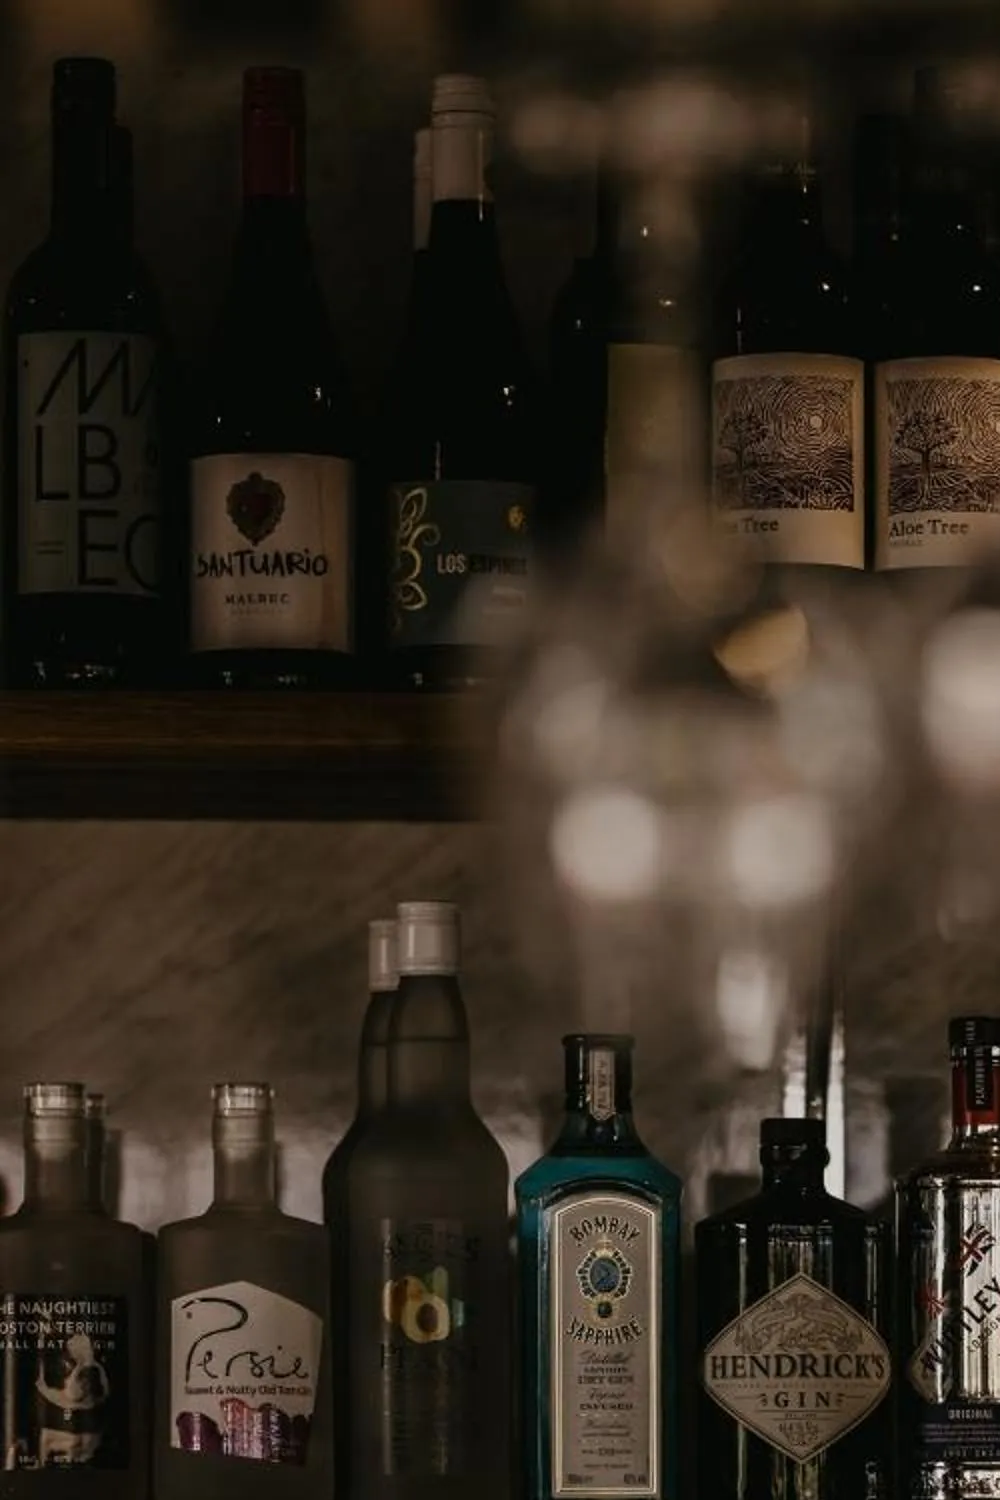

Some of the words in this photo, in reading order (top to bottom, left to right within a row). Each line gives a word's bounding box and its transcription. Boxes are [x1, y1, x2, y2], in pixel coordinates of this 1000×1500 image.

[889, 520, 924, 537] Aloe
[927, 519, 969, 535] Tree
[436, 552, 466, 574] LOS
[569, 1217, 639, 1241] BOMBAY
[19, 1301, 116, 1315] NAUGHTIEST
[58, 1321, 116, 1335] TERRIER
[566, 1317, 641, 1346] SAPPHIRE
[712, 1353, 885, 1380] HENDRICK'S
[775, 1391, 832, 1408] GIN
[947, 1408, 993, 1420] ORIGINAL
